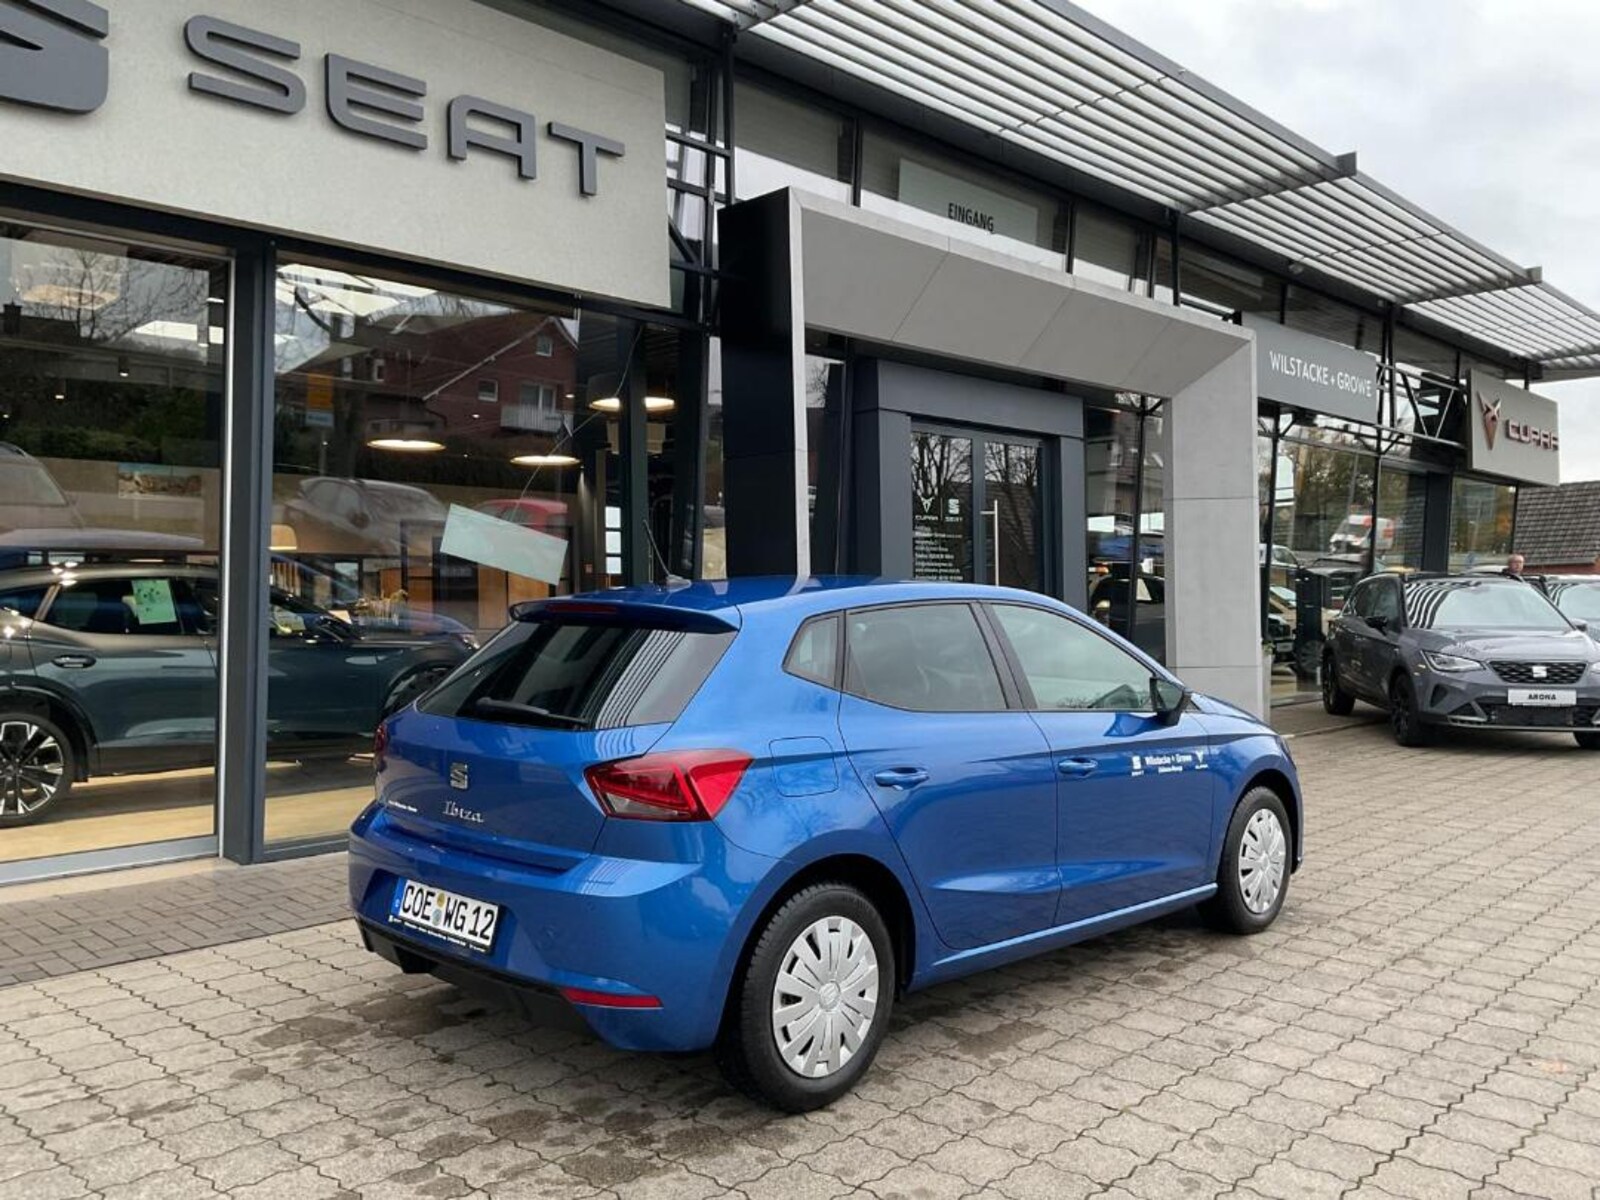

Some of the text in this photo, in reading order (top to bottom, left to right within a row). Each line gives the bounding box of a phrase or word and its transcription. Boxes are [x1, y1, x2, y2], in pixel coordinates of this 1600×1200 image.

[183, 14, 625, 196] SEAT
[948, 202, 994, 232] EINGANG
[1269, 350, 1329, 386] WILSTACKE
[1337, 371, 1373, 398] GROWE
[1528, 693, 1557, 701] ARONA
[443, 800, 485, 823] Ibiza
[402, 885, 435, 921] COE
[443, 897, 468, 932] WG
[468, 906, 495, 941] 12
